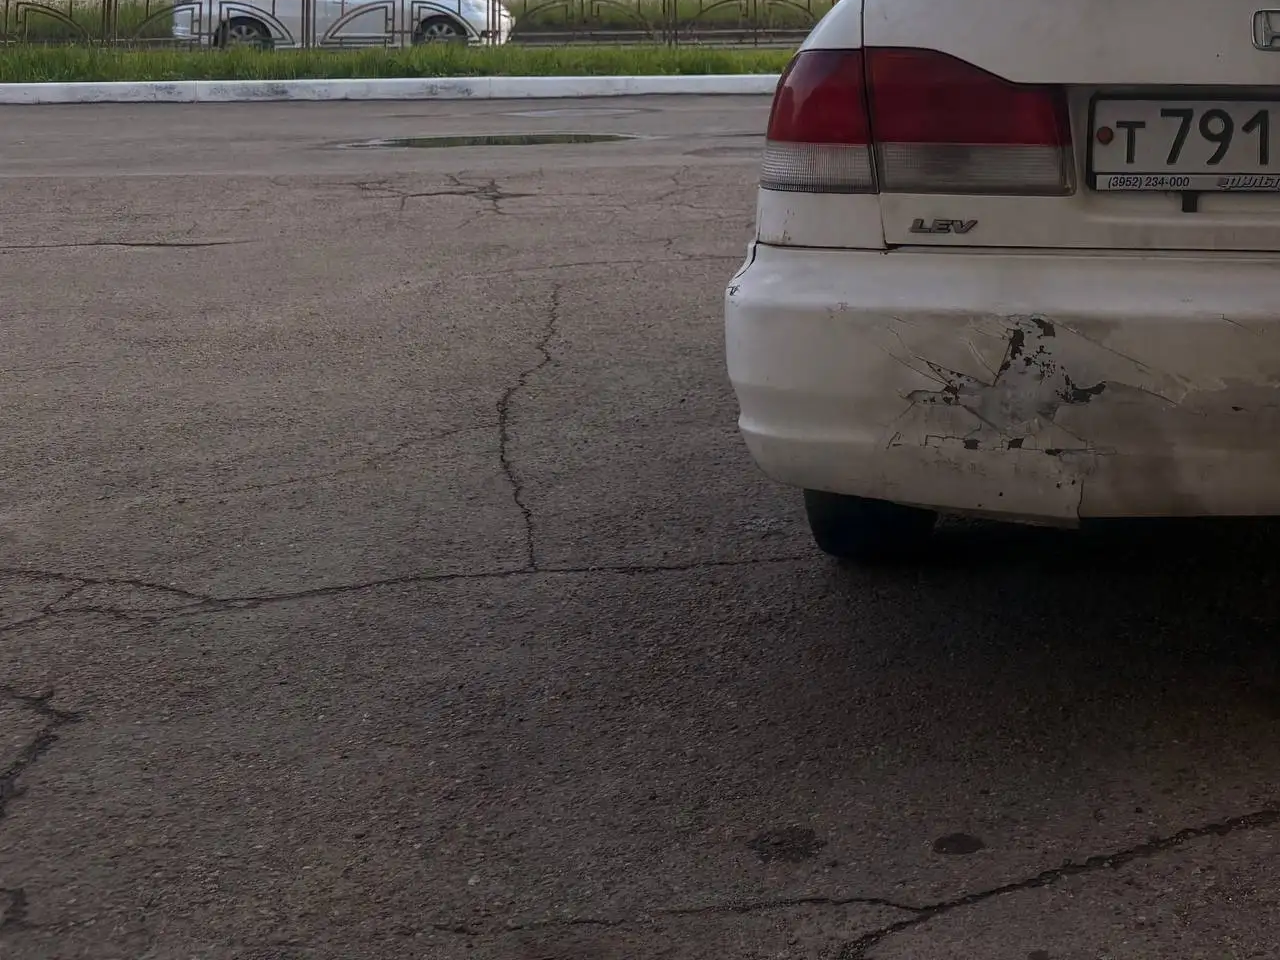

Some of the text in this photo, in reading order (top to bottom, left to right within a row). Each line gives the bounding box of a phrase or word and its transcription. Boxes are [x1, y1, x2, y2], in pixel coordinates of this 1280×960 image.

[1108, 175, 1190, 189] (3952) 234-000
[909, 218, 979, 234] LEV
